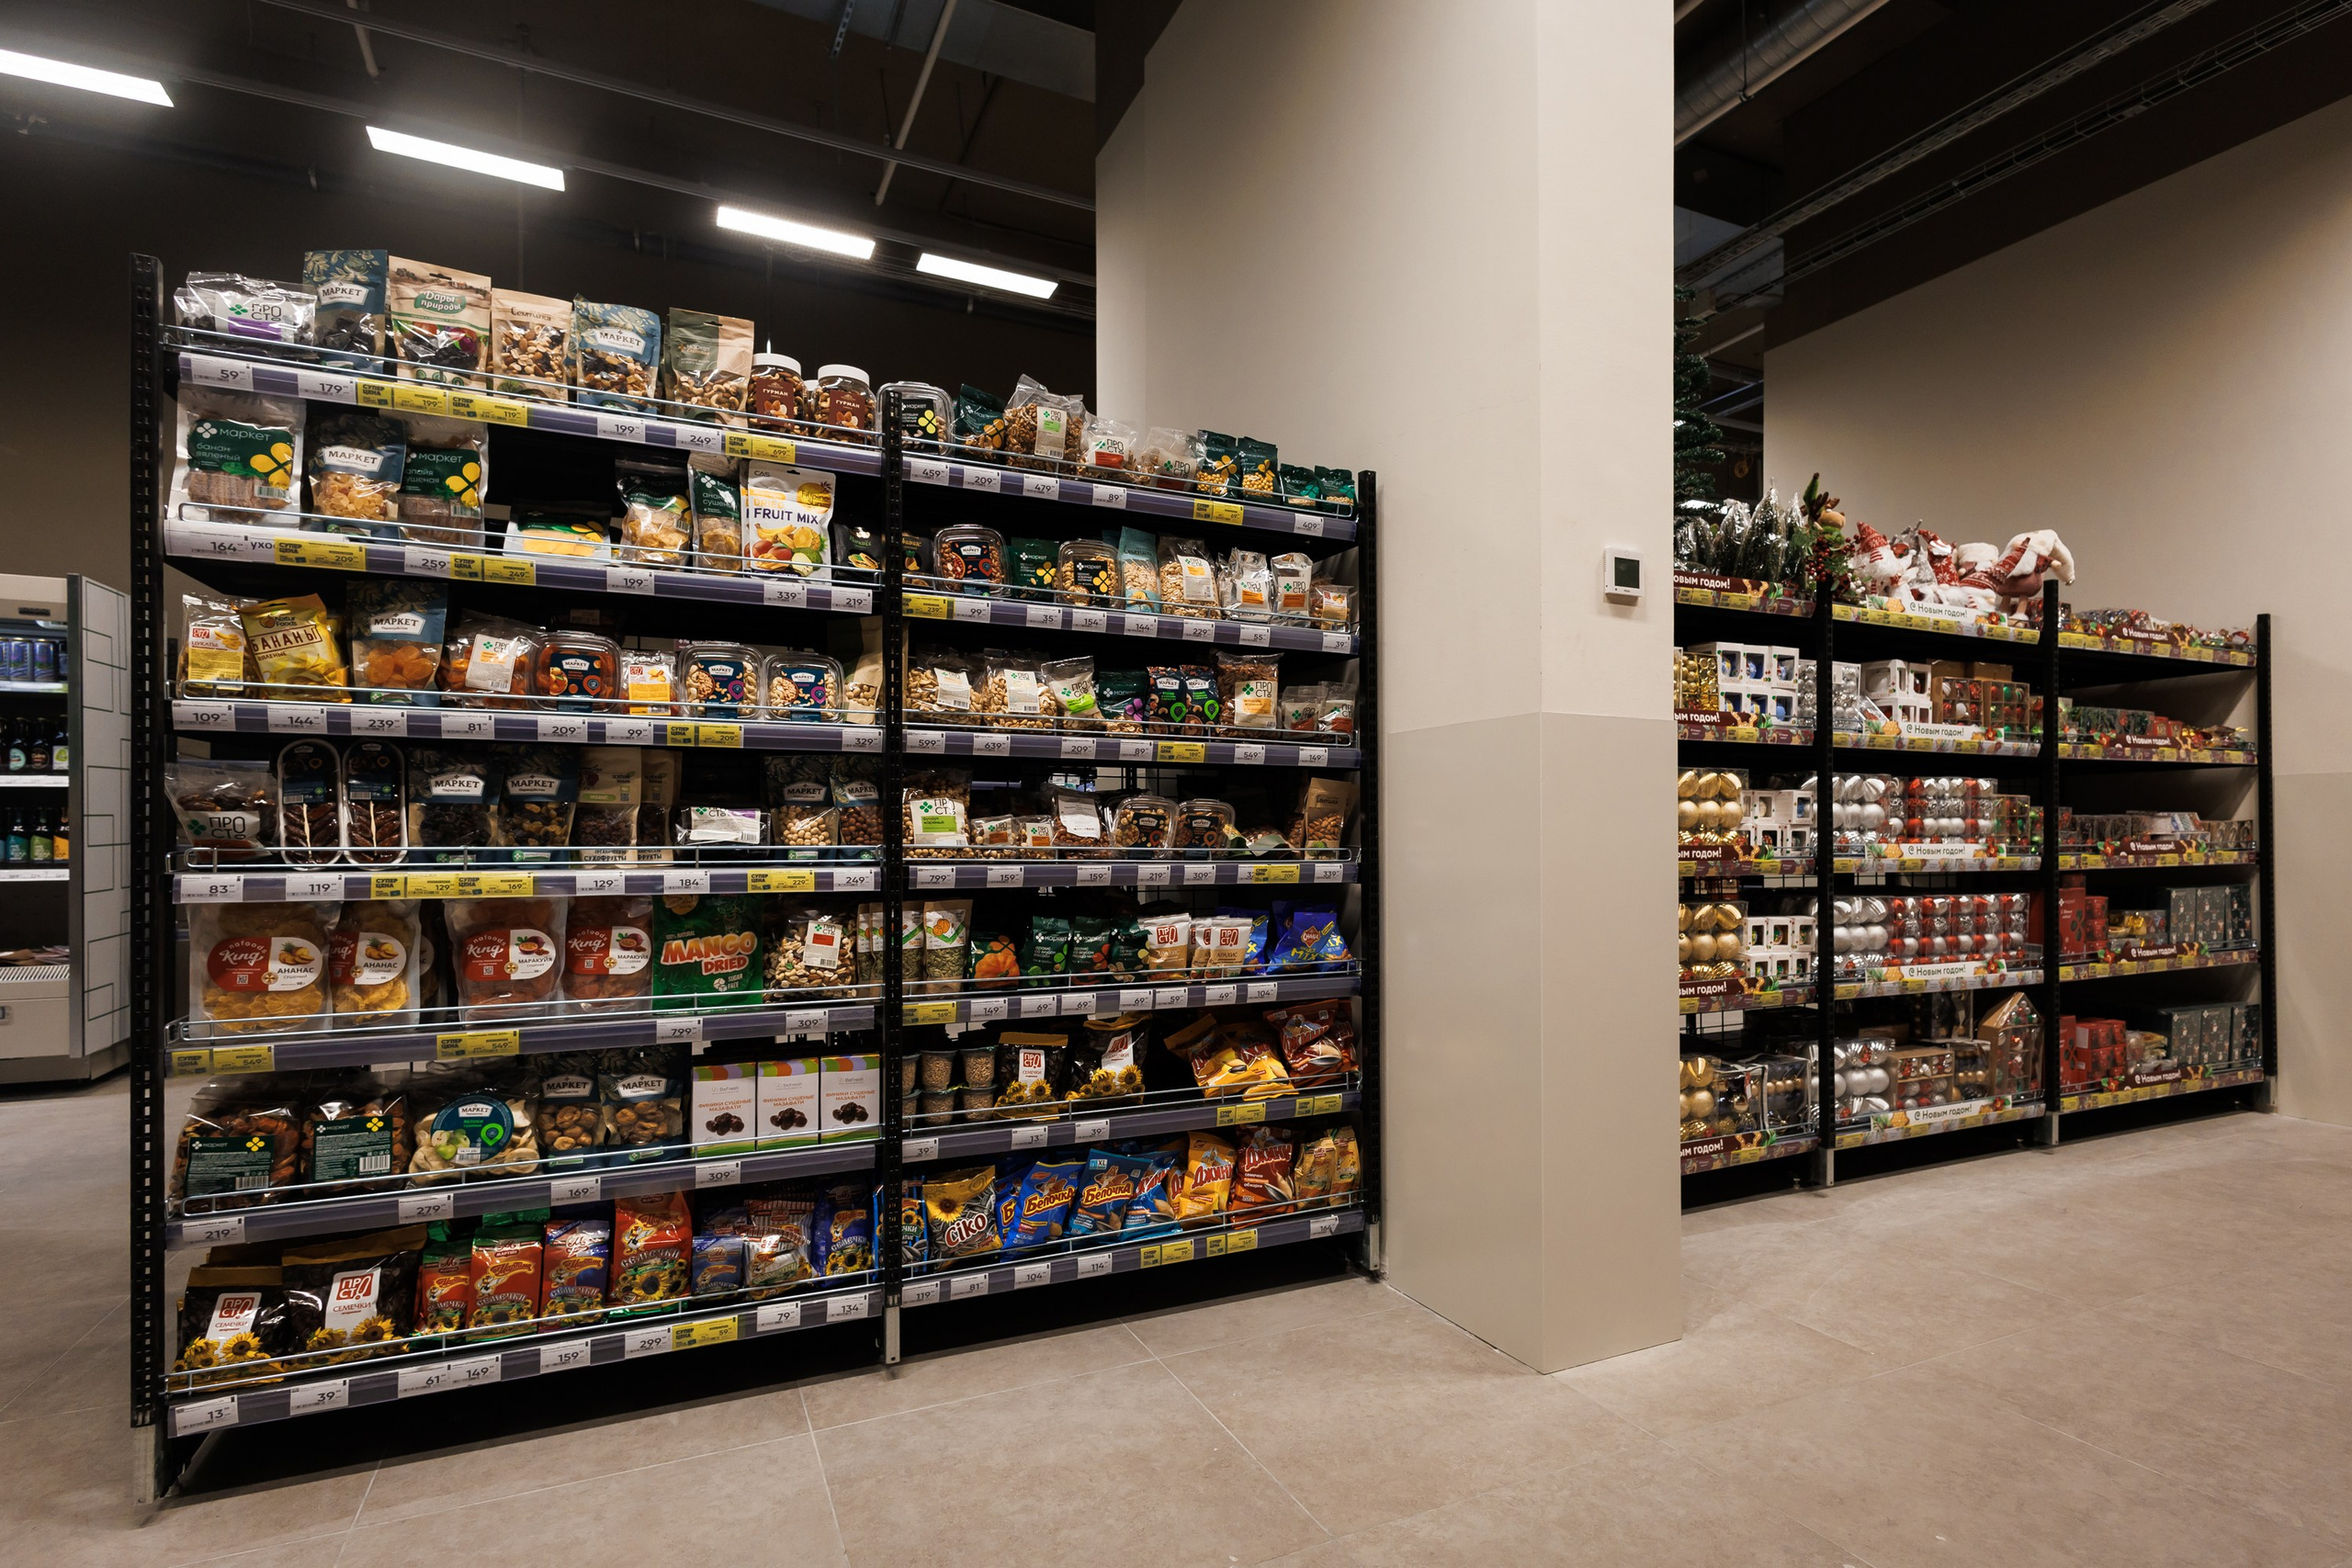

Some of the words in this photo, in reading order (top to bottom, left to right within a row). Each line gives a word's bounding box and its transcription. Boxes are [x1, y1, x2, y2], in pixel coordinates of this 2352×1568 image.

[322, 287, 363, 297] МАРКЕТ
[425, 291, 455, 303] Дары
[421, 299, 460, 313] природы
[599, 332, 642, 346] МАРКЕТ
[220, 369, 238, 380] 59
[320, 383, 341, 393] 179
[763, 388, 788, 397] ГУРМАН
[835, 400, 860, 409] ГУРМАН
[614, 423, 635, 434] 199
[220, 428, 271, 442] маркет
[690, 434, 711, 445] 249
[196, 443, 231, 452] банан
[195, 450, 241, 462] вяленый
[328, 450, 378, 464] МАРКЕТ
[419, 453, 463, 463] маркет
[922, 468, 942, 478] 459
[975, 476, 992, 484] 209
[1035, 483, 1051, 492] 479
[753, 499, 785, 509] DRIED
[754, 508, 793, 521] FRUIT
[797, 513, 819, 525] MIX
[210, 541, 236, 552] 164
[334, 555, 354, 563] 209
[422, 558, 447, 569] 259
[623, 577, 643, 586] 199
[1703, 577, 1730, 590] годом!
[776, 591, 797, 601] 339
[846, 597, 863, 605] 219
[970, 608, 983, 616] 99
[1918, 604, 1941, 615] Новым
[1942, 607, 1968, 618] годом!
[374, 616, 419, 627] МАРКЕТ
[2129, 628, 2148, 637] Новым
[2149, 631, 2167, 640] годом!
[250, 627, 318, 652] БАНАНЫ
[192, 713, 220, 723] 109
[288, 716, 313, 726] 144
[1693, 712, 1721, 723] годом!
[368, 719, 393, 728] 239
[468, 722, 481, 731] 81
[552, 726, 576, 735] 209
[628, 728, 643, 737] 99
[1915, 726, 1938, 735] Новым
[1940, 728, 1964, 739] годом!
[854, 738, 874, 746] 329
[2132, 736, 2152, 745] Новым
[2153, 737, 2171, 746] годом!
[435, 779, 480, 789] МАРКЕТ
[511, 779, 555, 789] МАРКЕТ
[787, 788, 823, 797] МАРКЕТ
[848, 786, 876, 795] МАРКЕТ
[1916, 846, 1939, 855] Новым
[1941, 846, 1966, 857] годом!
[2136, 842, 2154, 852] Новым
[2155, 841, 2175, 852] годом!
[1692, 847, 1722, 859] годом!
[594, 879, 614, 887] 129
[679, 878, 699, 886] 184
[846, 875, 865, 884] 249
[209, 885, 228, 895] 83
[309, 883, 331, 892] 119
[473, 934, 505, 947] nafoods
[577, 929, 607, 942] nafoods
[230, 940, 267, 953] nafoods
[568, 938, 605, 953] King
[661, 931, 757, 965] MANGO
[467, 944, 504, 958] King
[2137, 948, 2156, 957] Новым
[2157, 946, 2177, 956] годом!
[219, 949, 265, 966] King
[702, 955, 749, 976] DRIED
[1917, 966, 1940, 976] Новым
[1942, 964, 1966, 976] годом!
[728, 974, 743, 982] SUGAR
[1697, 982, 1727, 995] годом!
[797, 1019, 819, 1027] 309
[671, 1026, 692, 1036] 799
[243, 1057, 262, 1066] 549
[2141, 1073, 2160, 1083] Новым
[2161, 1071, 2181, 1081] годом!
[547, 1081, 588, 1091] МАРКЕТ
[622, 1079, 662, 1089] МАРКЕТ
[1923, 1110, 1946, 1120] Новым
[1947, 1104, 1973, 1117] годом!
[1693, 1140, 1724, 1154] годом!
[708, 1171, 729, 1180] 309
[568, 1188, 589, 1197] 169
[417, 1205, 440, 1214] 279
[206, 1230, 230, 1238] 219
[945, 1213, 988, 1247] Ciko
[1026, 1272, 1042, 1280] 104
[333, 1303, 372, 1313] СЕМЕЧКИ
[842, 1303, 859, 1313] 134
[777, 1312, 790, 1321] 79
[639, 1337, 662, 1348] 299
[558, 1351, 580, 1361] 159
[466, 1368, 489, 1377] 149
[426, 1375, 441, 1384] 61
[317, 1392, 335, 1402] 39
[208, 1409, 223, 1419] 13
